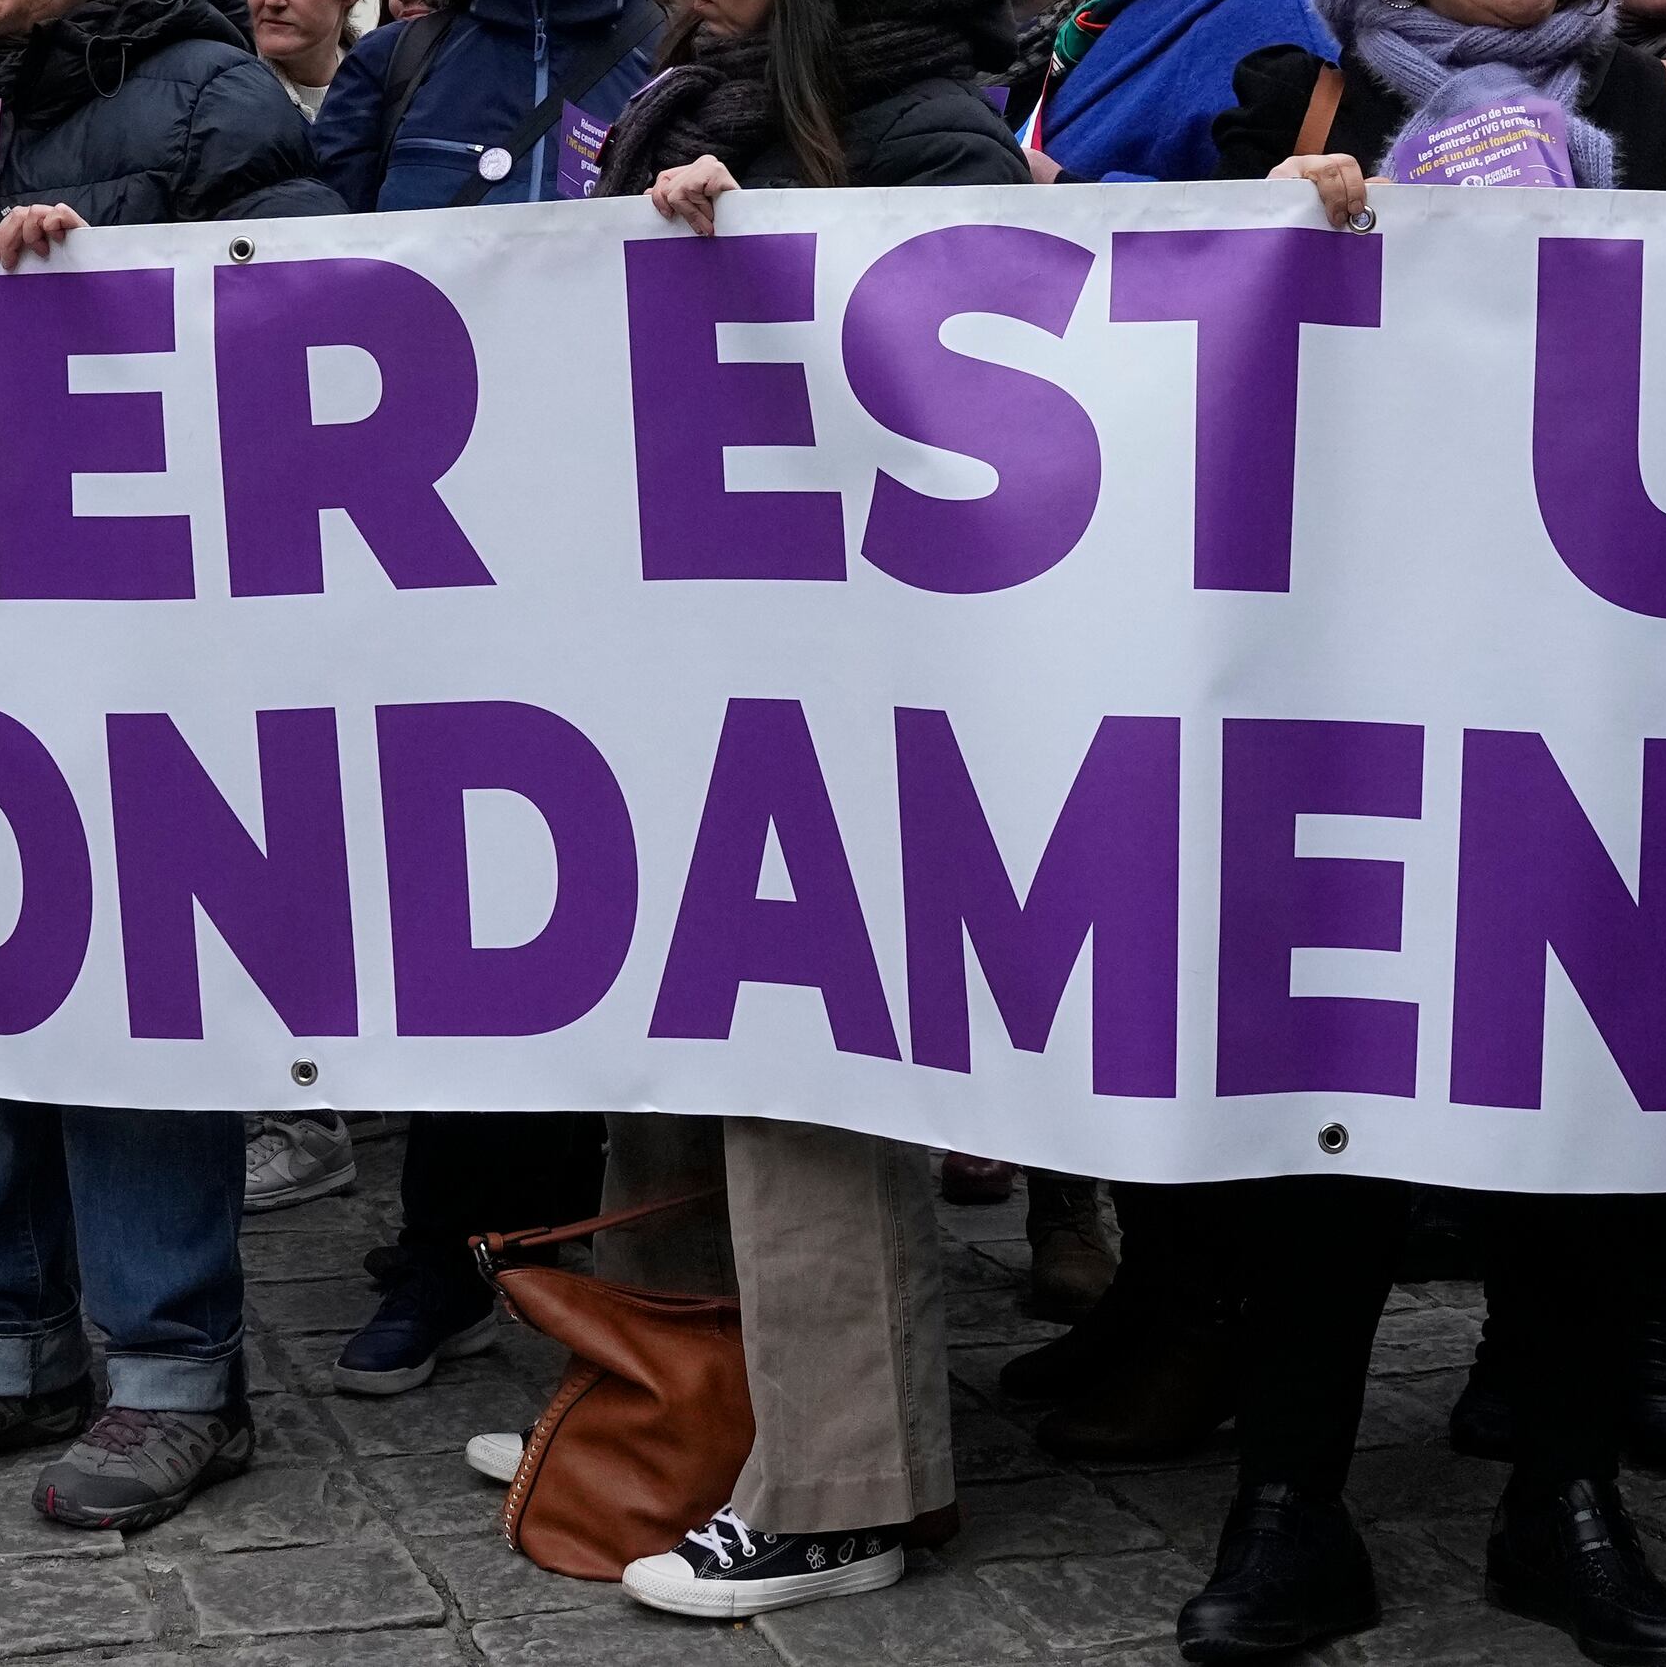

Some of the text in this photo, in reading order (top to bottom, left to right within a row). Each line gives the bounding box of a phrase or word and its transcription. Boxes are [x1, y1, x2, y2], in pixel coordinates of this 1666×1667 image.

[1417, 149, 1433, 162] les
[1434, 135, 1472, 154] centres
[1473, 122, 1499, 140] d'IVG
[1500, 115, 1536, 131] fermés
[1428, 104, 1526, 144] Réouverture de tous
[1434, 153, 1450, 168] est
[1450, 150, 1463, 162] un
[1464, 141, 1488, 157] droit
[1489, 129, 1550, 148] fondamental
[1444, 157, 1484, 178] gratuit,
[1484, 144, 1522, 165] partout
[623, 224, 1383, 594] EST
